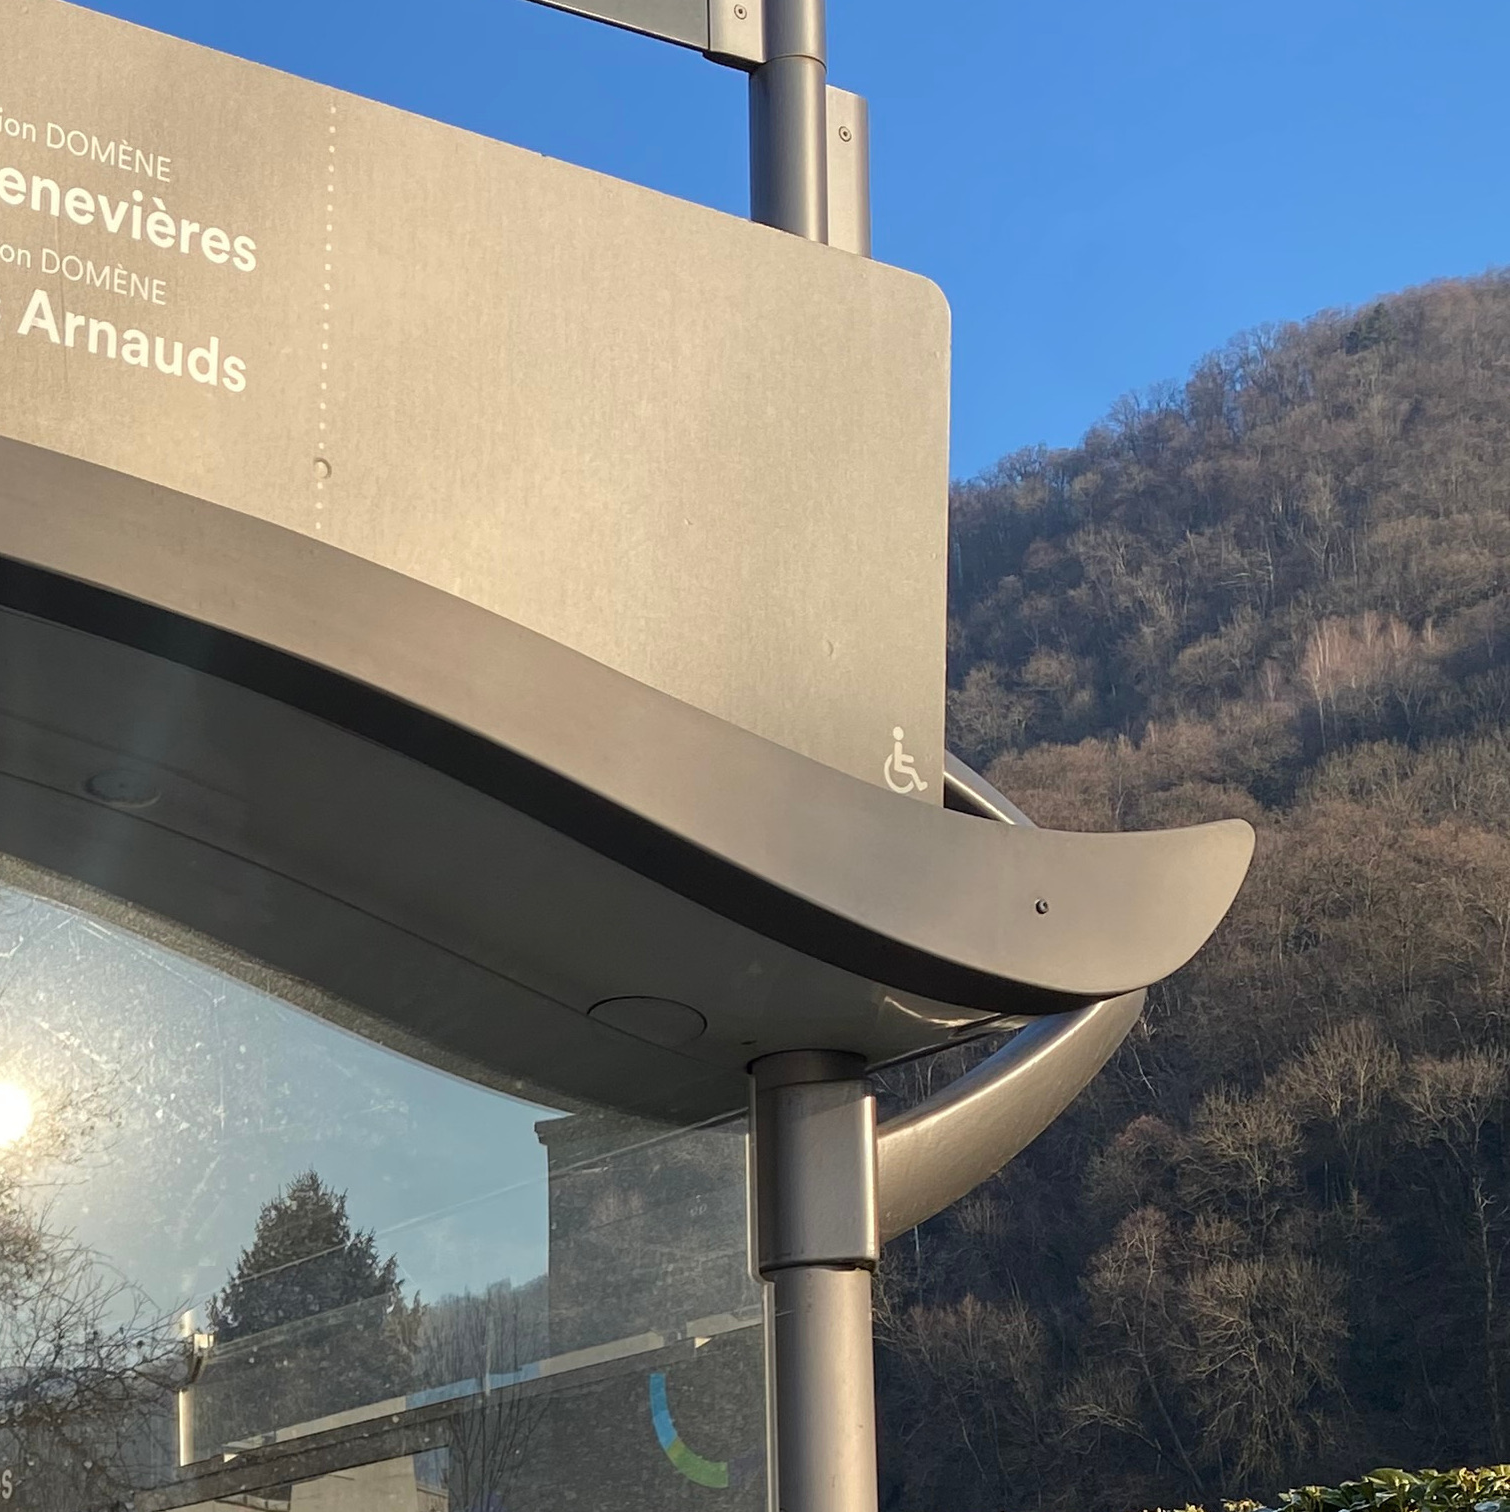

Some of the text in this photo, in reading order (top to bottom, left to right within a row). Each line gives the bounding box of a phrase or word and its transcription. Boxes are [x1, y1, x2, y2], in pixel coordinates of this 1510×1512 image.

[45, 121, 172, 183] DOMÈNE
[40, 247, 167, 306] DOMÈNE
[16, 287, 248, 393] Arnauds
